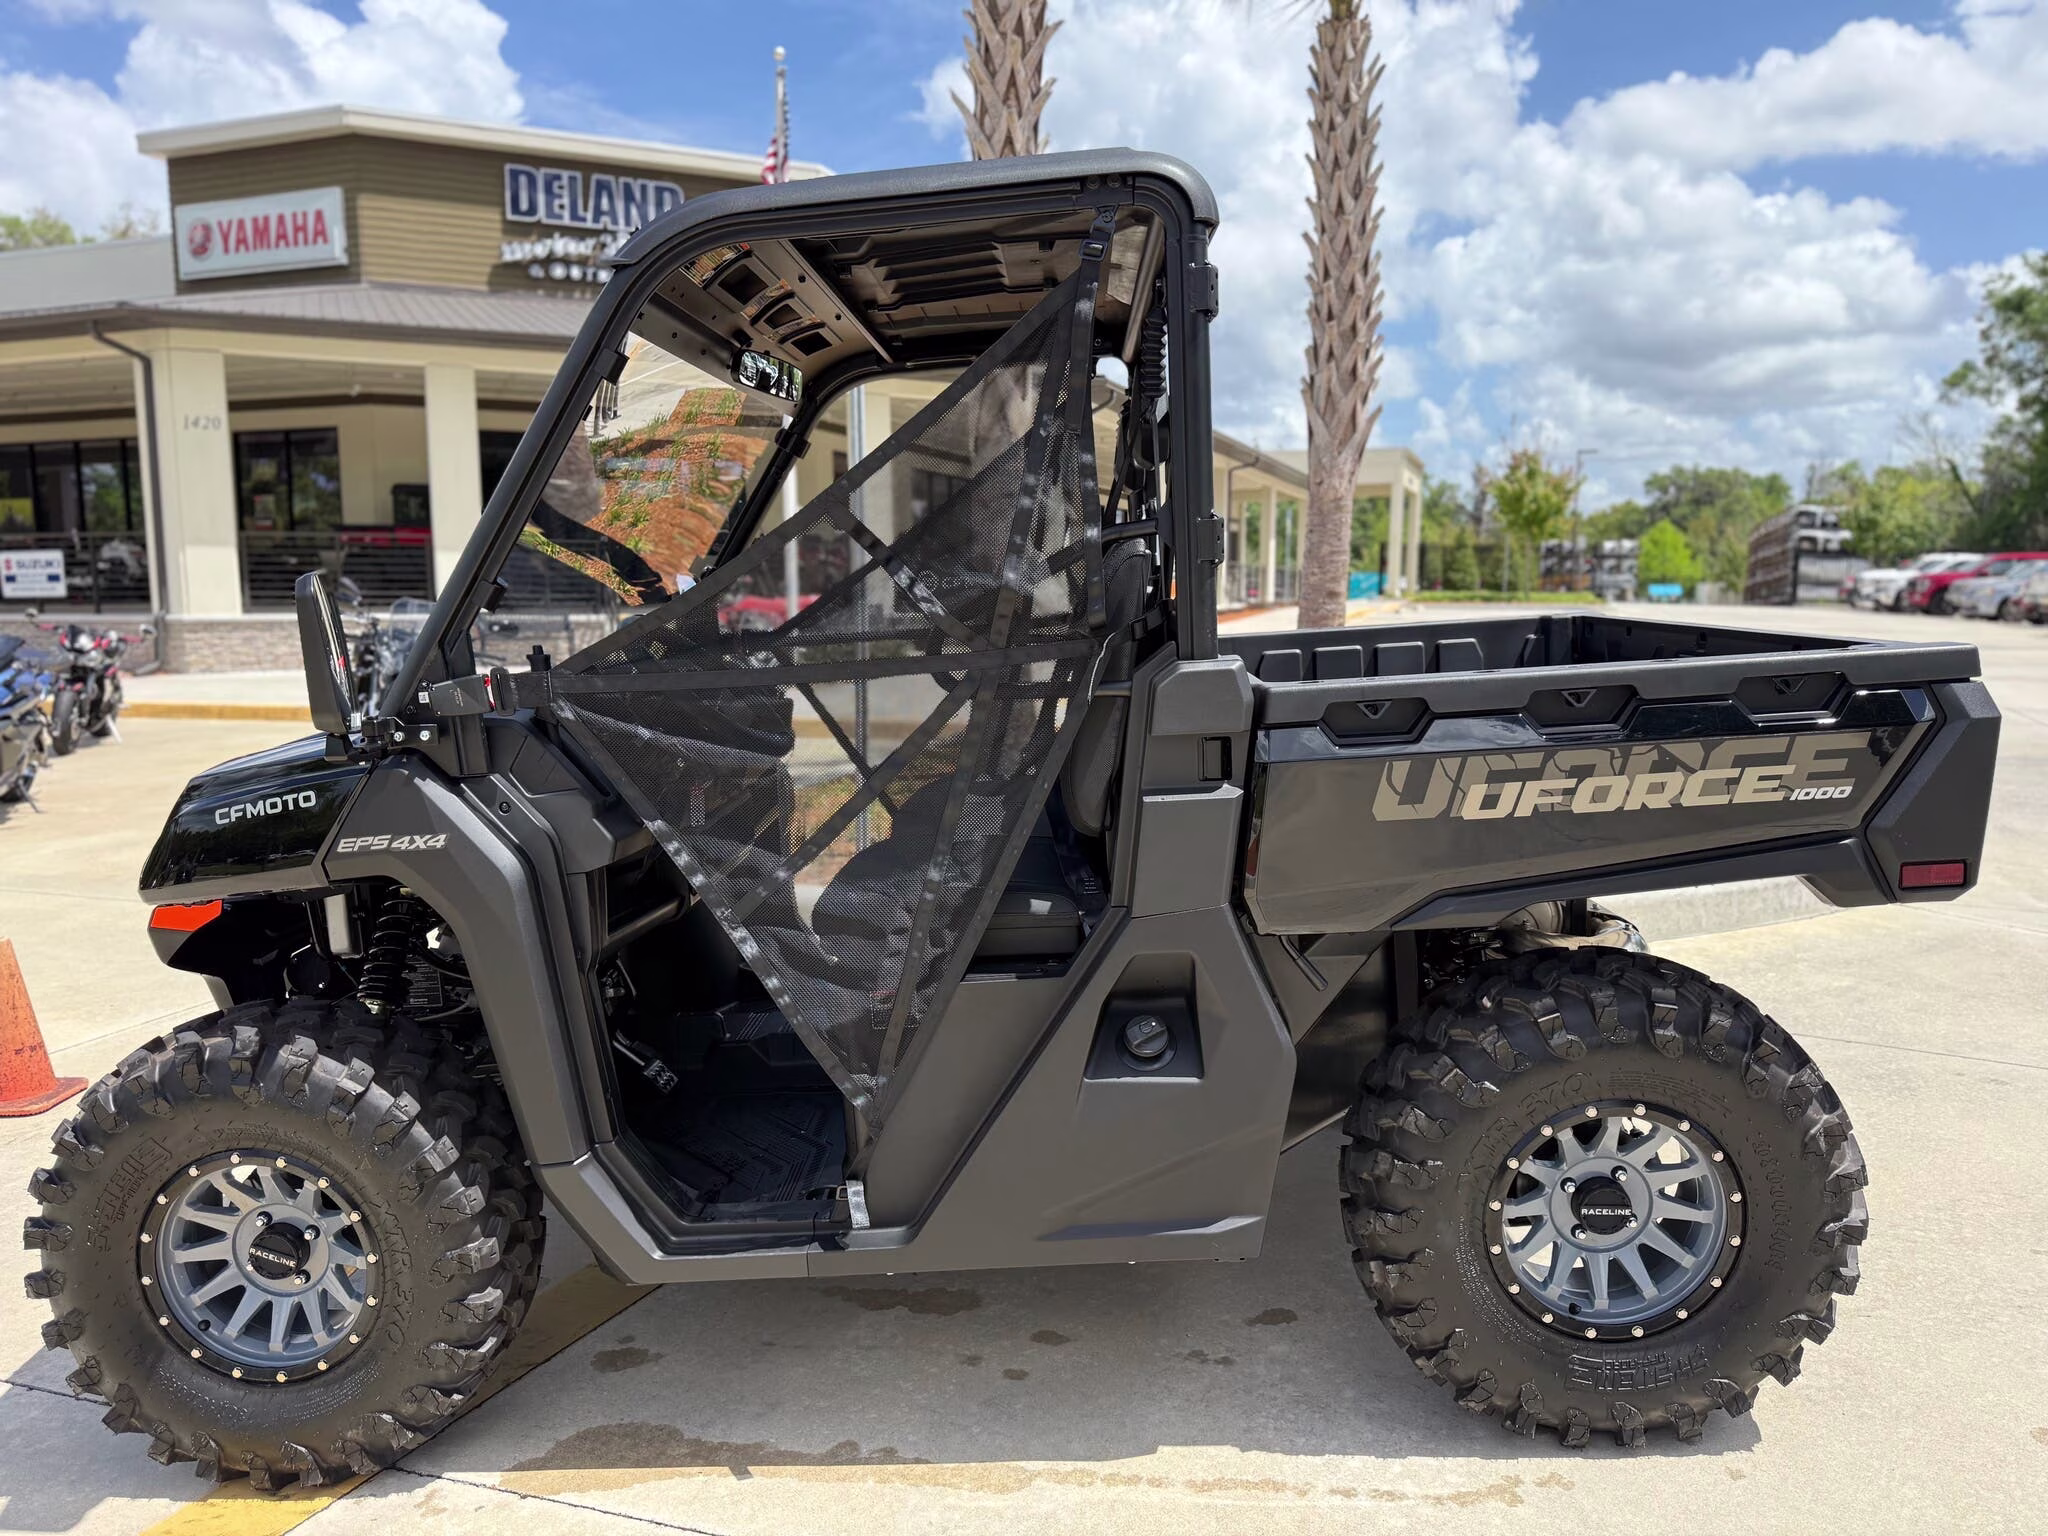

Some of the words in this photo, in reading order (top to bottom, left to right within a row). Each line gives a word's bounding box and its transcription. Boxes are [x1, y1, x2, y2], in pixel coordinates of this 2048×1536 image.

[504, 163, 685, 232] DELAND
[217, 208, 330, 256] YAMAHA
[183, 413, 222, 431] 1420
[15, 558, 61, 570] SUZUKI
[1460, 764, 1797, 821] UFORCE
[1789, 785, 1853, 801] 1000
[214, 789, 317, 825] CFMOTO
[336, 834, 391, 852] EPS
[391, 833, 449, 851] 4X4
[1580, 1208, 1632, 1216] RACELINE
[249, 1247, 297, 1268] RACELINE
